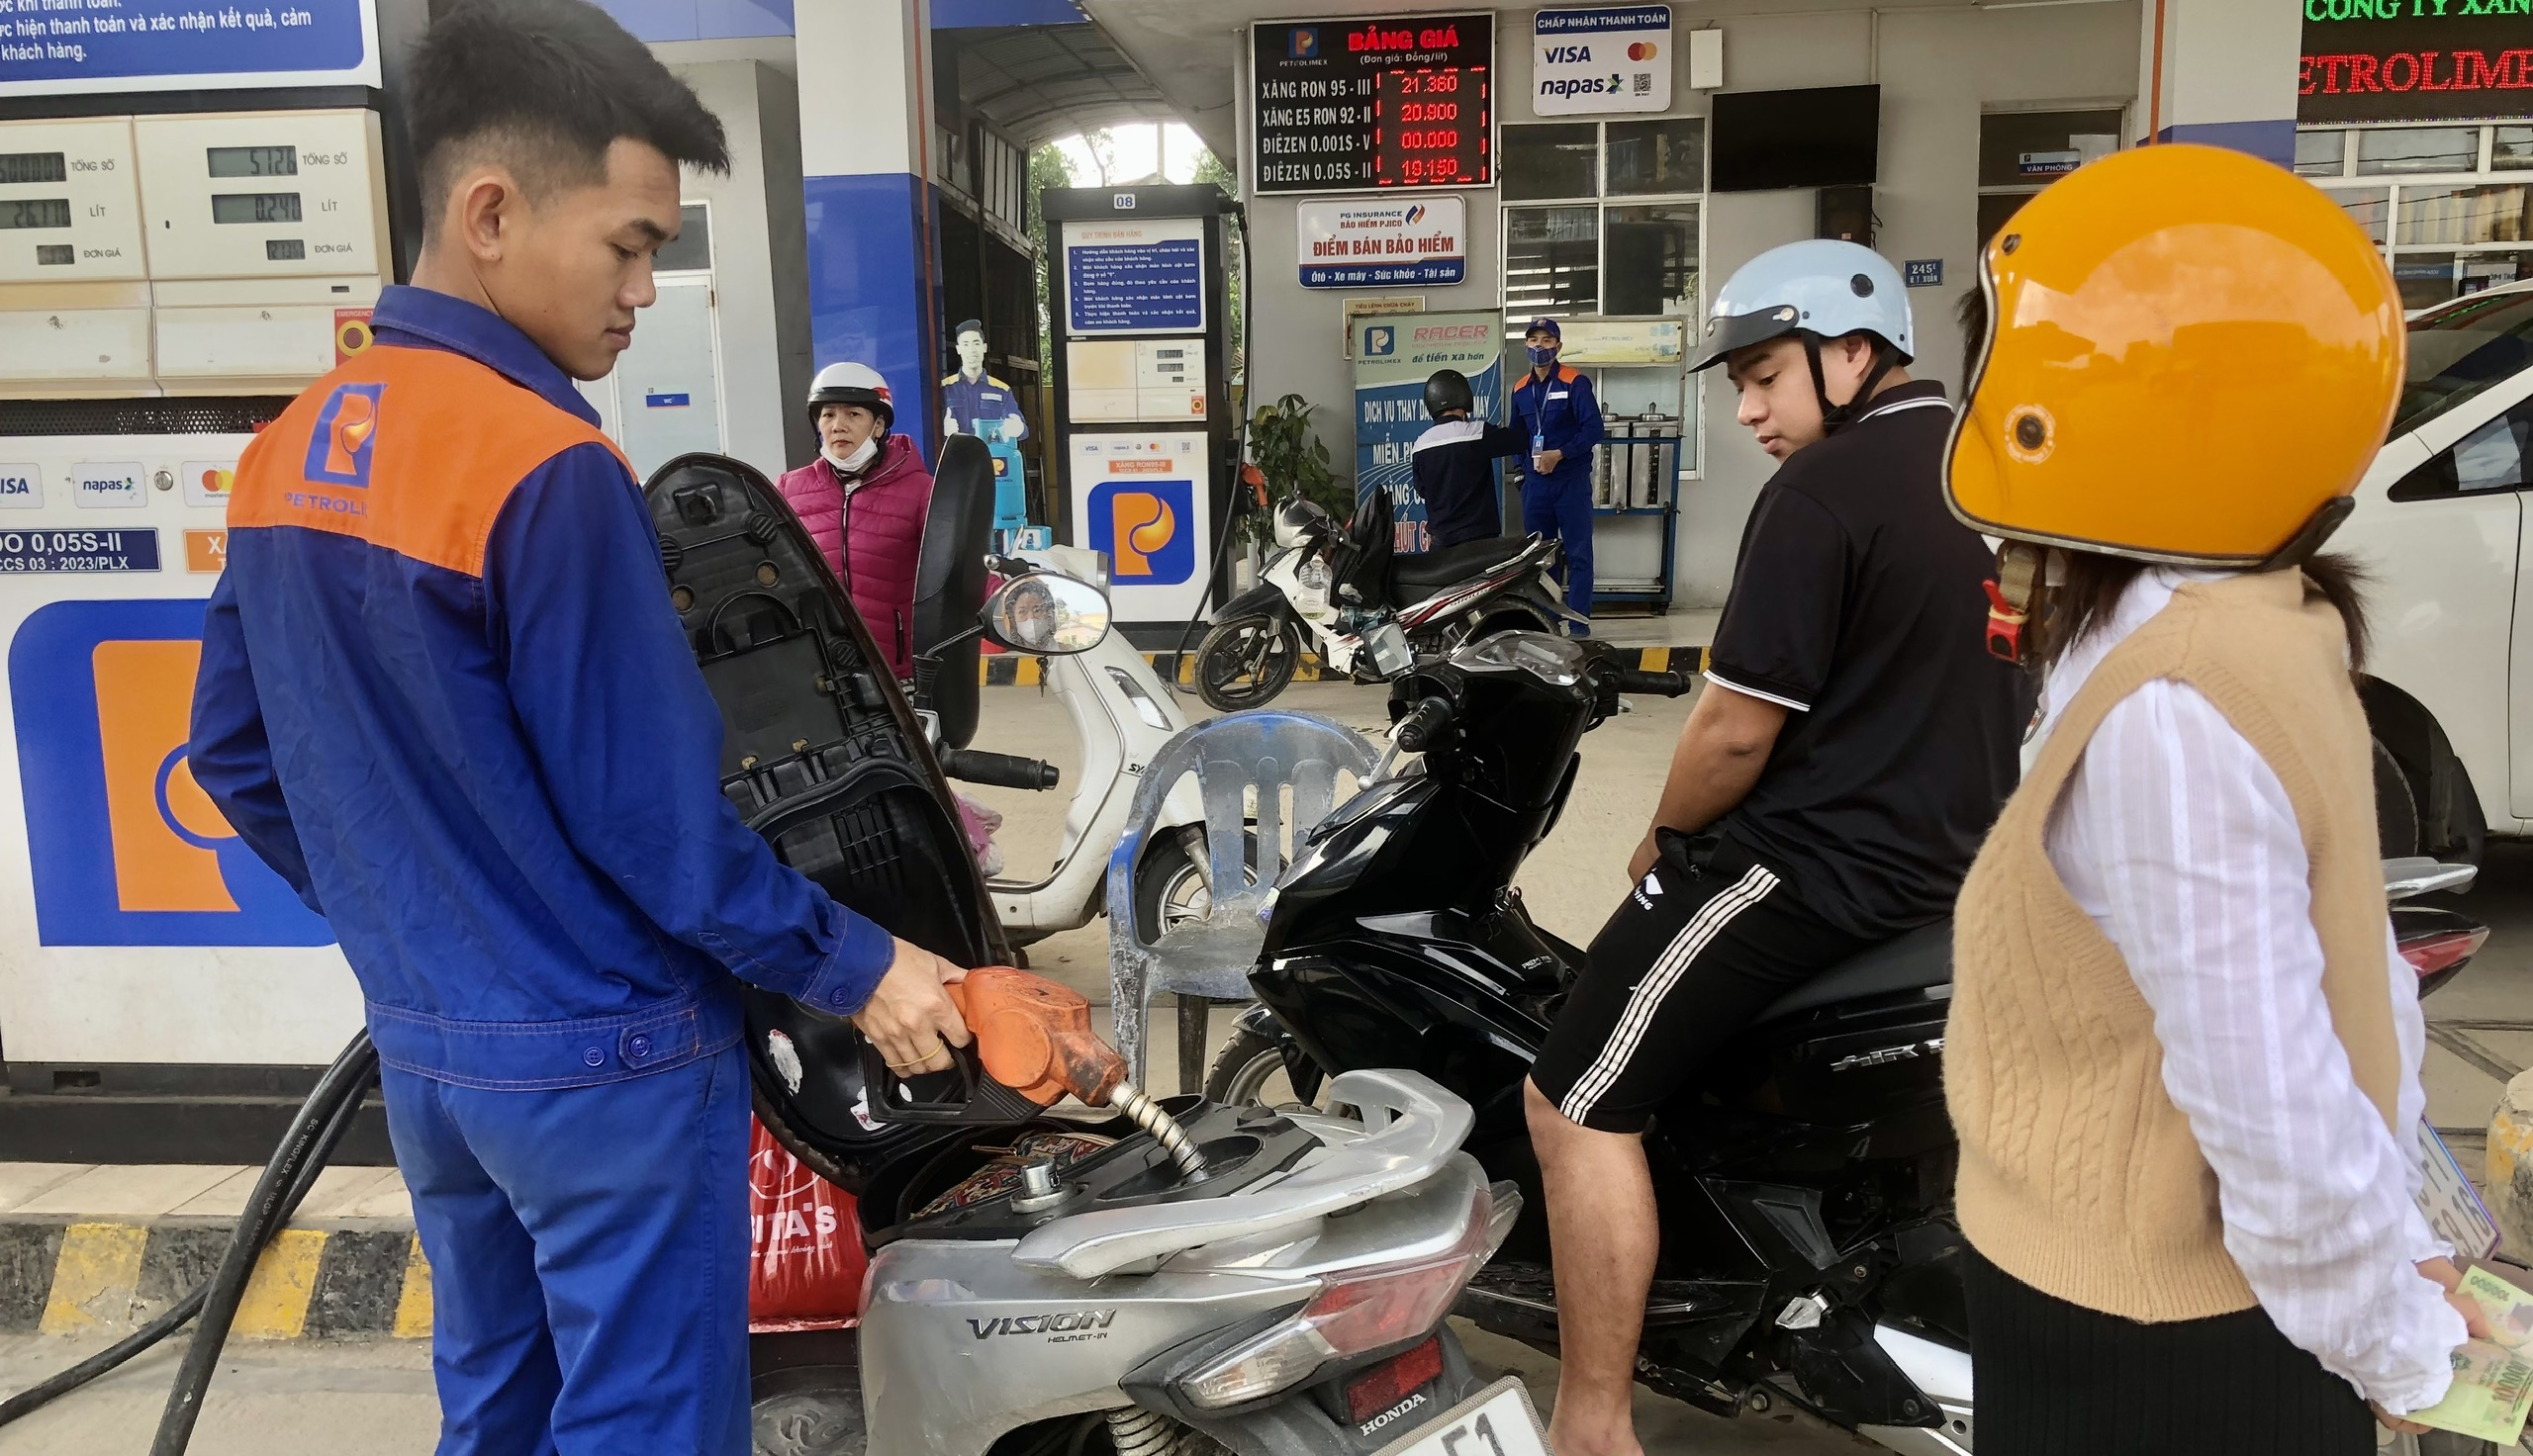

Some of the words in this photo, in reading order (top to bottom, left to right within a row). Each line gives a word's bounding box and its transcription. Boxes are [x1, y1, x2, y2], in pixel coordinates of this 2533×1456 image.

[16, 18, 46, 39] hiện
[50, 17, 91, 35] thanh
[94, 15, 126, 33] toán
[130, 13, 147, 32] và
[150, 13, 175, 31] xác
[180, 11, 215, 34] nhận
[219, 6, 242, 28] kết
[245, 8, 277, 31] quả,
[281, 7, 312, 27] cảm
[1538, 16, 1565, 28] CHẤP
[1568, 17, 1597, 28] NHẬN
[1599, 15, 1635, 25] THANH
[1638, 13, 1666, 24] TOÁN
[1349, 25, 1412, 50] BẢNG
[1420, 24, 1459, 48] GIÁ
[1, 43, 43, 61] khách
[47, 42, 87, 62] hàng.
[1360, 53, 1383, 65] (Đơn
[1385, 53, 1403, 65] giá:
[1406, 51, 1448, 63] Đồng/lít)
[1543, 46, 1591, 63] VISA
[1263, 80, 1296, 99] XĂNG
[1301, 81, 1326, 97] RON
[1330, 80, 1346, 96] 95
[1401, 75, 1457, 94] 21.360
[1540, 78, 1604, 99] napas
[1263, 107, 1293, 127] XĂNG
[1296, 109, 1310, 125] E5
[1314, 108, 1336, 125] RON
[1340, 107, 1355, 124] 92
[1401, 103, 1457, 122] 20.900
[1263, 134, 1307, 154] ĐIÊZEN
[1311, 135, 1353, 152] 0.001S
[1363, 135, 1370, 150] V
[1401, 131, 1457, 148] 00.000
[71, 159, 97, 171] TỔNG
[101, 159, 115, 171] SỐ
[250, 149, 297, 175] 5126
[302, 152, 330, 165] TỔNG
[334, 152, 347, 165] SỐ
[1263, 161, 1310, 182] ĐIÊZEN
[1314, 163, 1351, 180] 0.05S
[1402, 159, 1457, 177] 19.150
[90, 204, 105, 217] LÍT
[322, 199, 337, 211] LÍT
[1116, 197, 1133, 207] 08
[1340, 220, 1356, 229] BẢO
[1358, 219, 1377, 228] HIỂM
[1380, 220, 1402, 228] PJICO
[84, 249, 103, 258] ĐƠN
[105, 247, 121, 258] GIÁ
[315, 245, 334, 254] ĐƠN
[336, 242, 353, 253] GIÁ
[1313, 234, 1348, 257] ĐIỂM
[1353, 236, 1381, 255] BÁN
[1386, 233, 1413, 254] BẢO
[1418, 231, 1454, 252] HIỂM
[1334, 272, 1345, 282] Xe
[1347, 271, 1366, 282] máy
[1375, 269, 1391, 280] Sức
[1413, 324, 1489, 341] RACER
[1427, 352, 1448, 363] tiến
[1364, 401, 1382, 429] DỊCH
[1385, 400, 1395, 428] VỤ
[1397, 399, 1417, 422] THAY
[1473, 390, 1490, 418] MÁY
[1373, 433, 1399, 464] MIỄN
[83, 479, 123, 493] napas
[285, 492, 368, 518] PETROLI
[32, 533, 122, 555] 0,05S-II
[30, 557, 46, 571] 03
[60, 556, 129, 571] 2023/PLX
[967, 1309, 1116, 1340] VISION
[1048, 1332, 1107, 1343] HELMET-IN
[1360, 1393, 1427, 1436] HONDA
